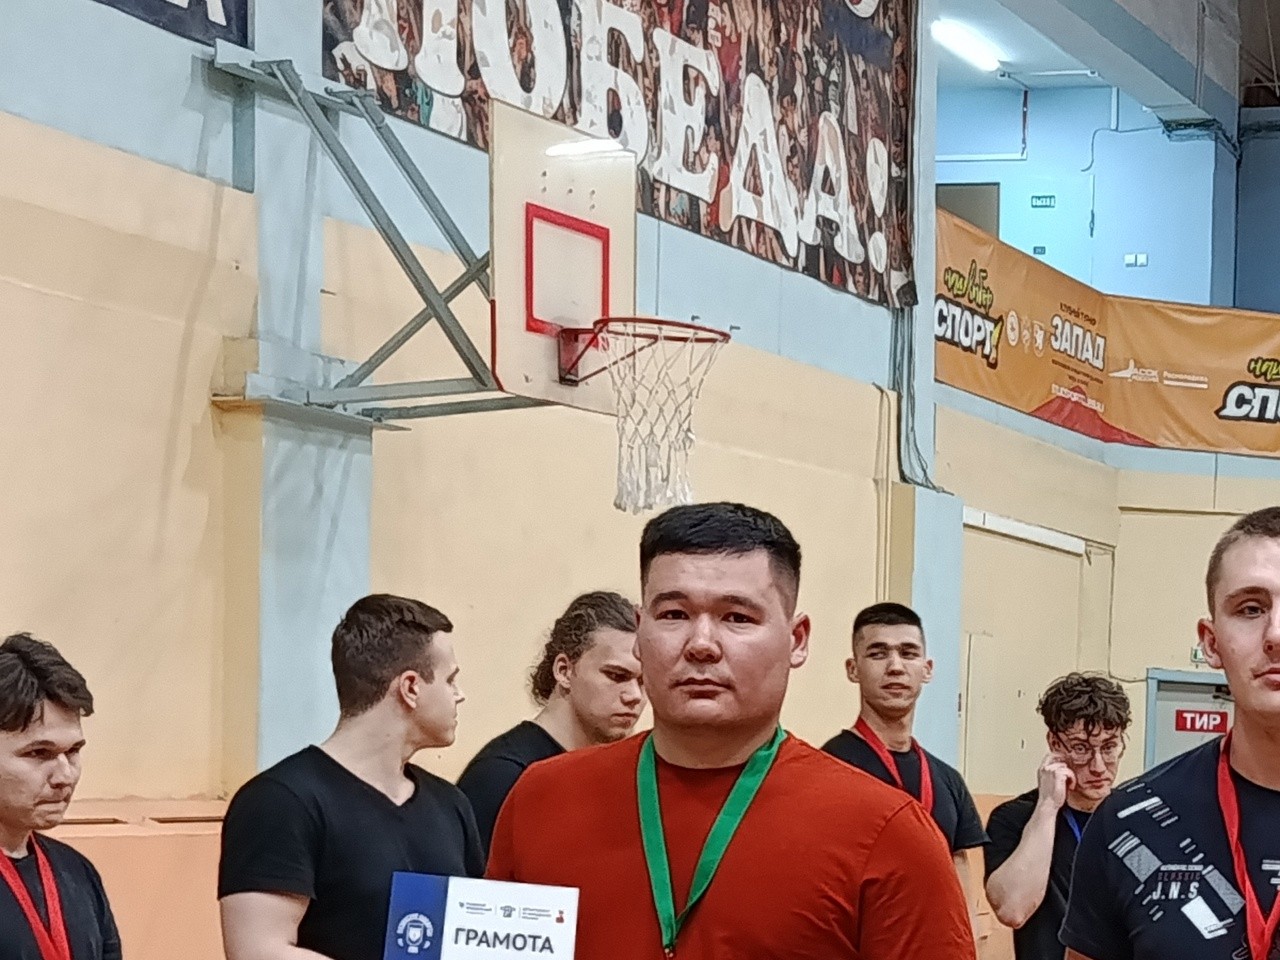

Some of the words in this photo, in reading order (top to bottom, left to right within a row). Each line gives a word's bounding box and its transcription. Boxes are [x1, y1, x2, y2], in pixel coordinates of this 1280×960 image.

[1051, 314, 1105, 371] ЗАПАД
[1182, 712, 1221, 731] ТИР
[454, 928, 554, 954] ГРАМОТА
